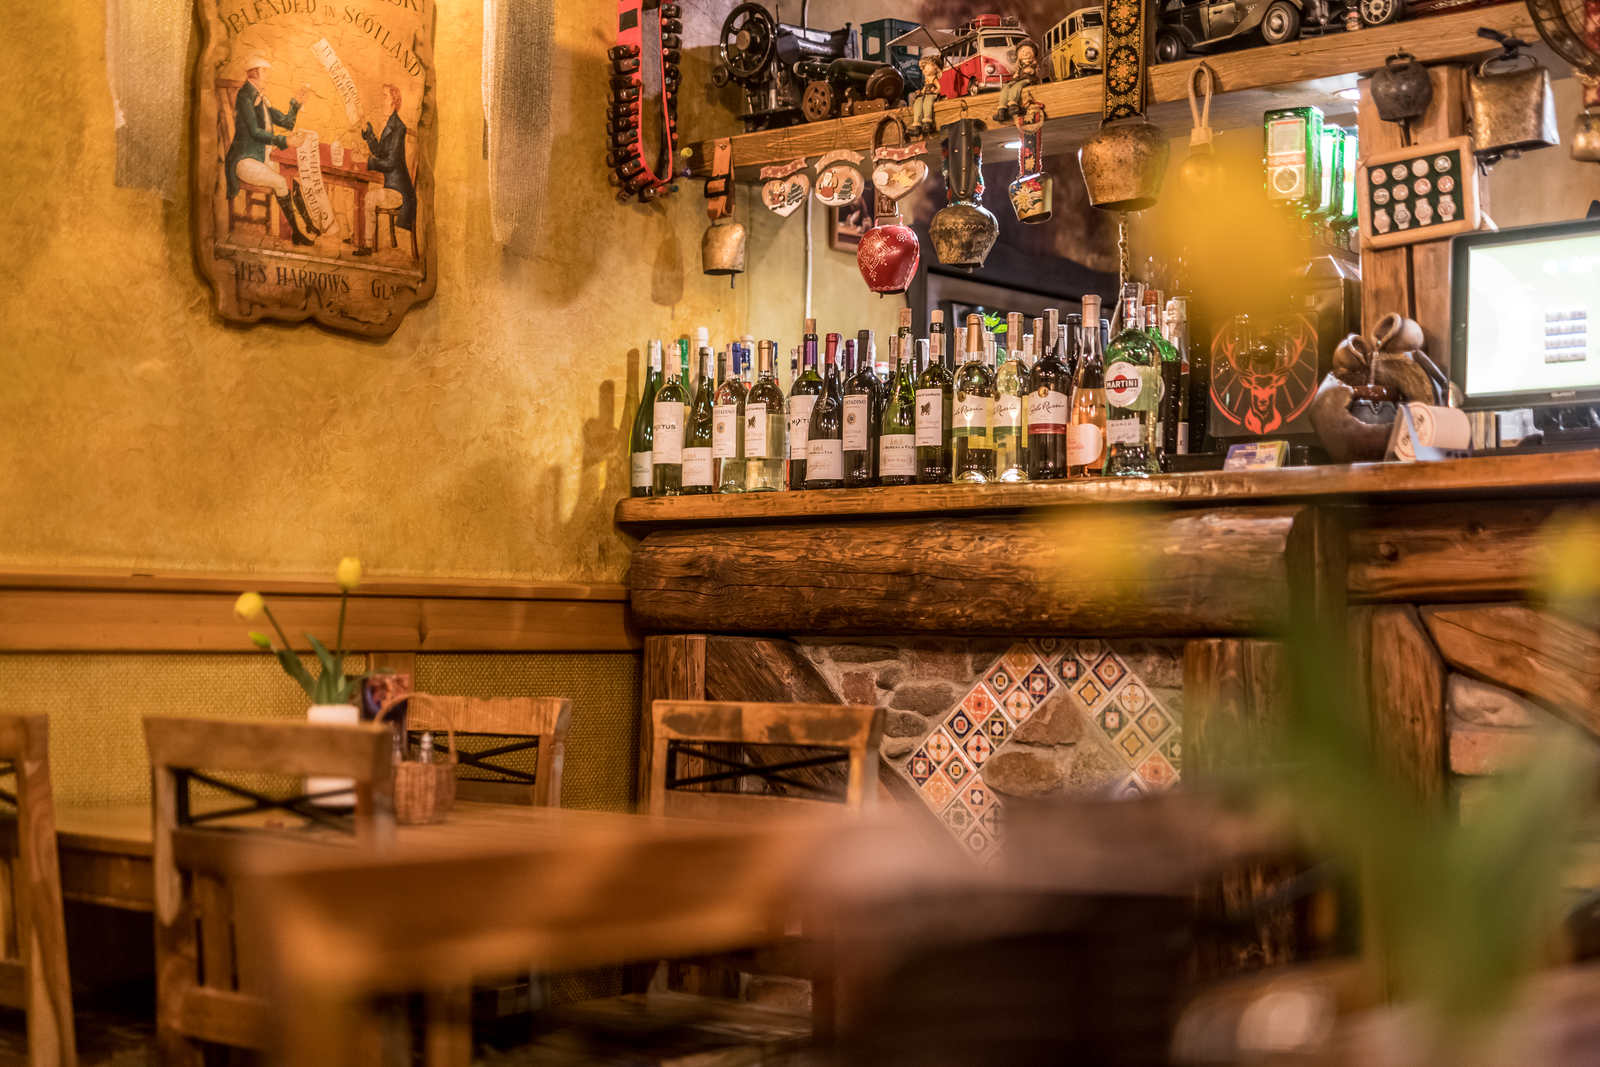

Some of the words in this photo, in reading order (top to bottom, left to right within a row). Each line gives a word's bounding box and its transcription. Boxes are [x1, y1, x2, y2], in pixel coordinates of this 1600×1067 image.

[227, 0, 316, 34] BLENDED
[324, 5, 336, 17] IN
[343, 5, 421, 78] SCOTLAND
[276, 266, 350, 293] HARROWS
[1106, 379, 1138, 389] MARTINI
